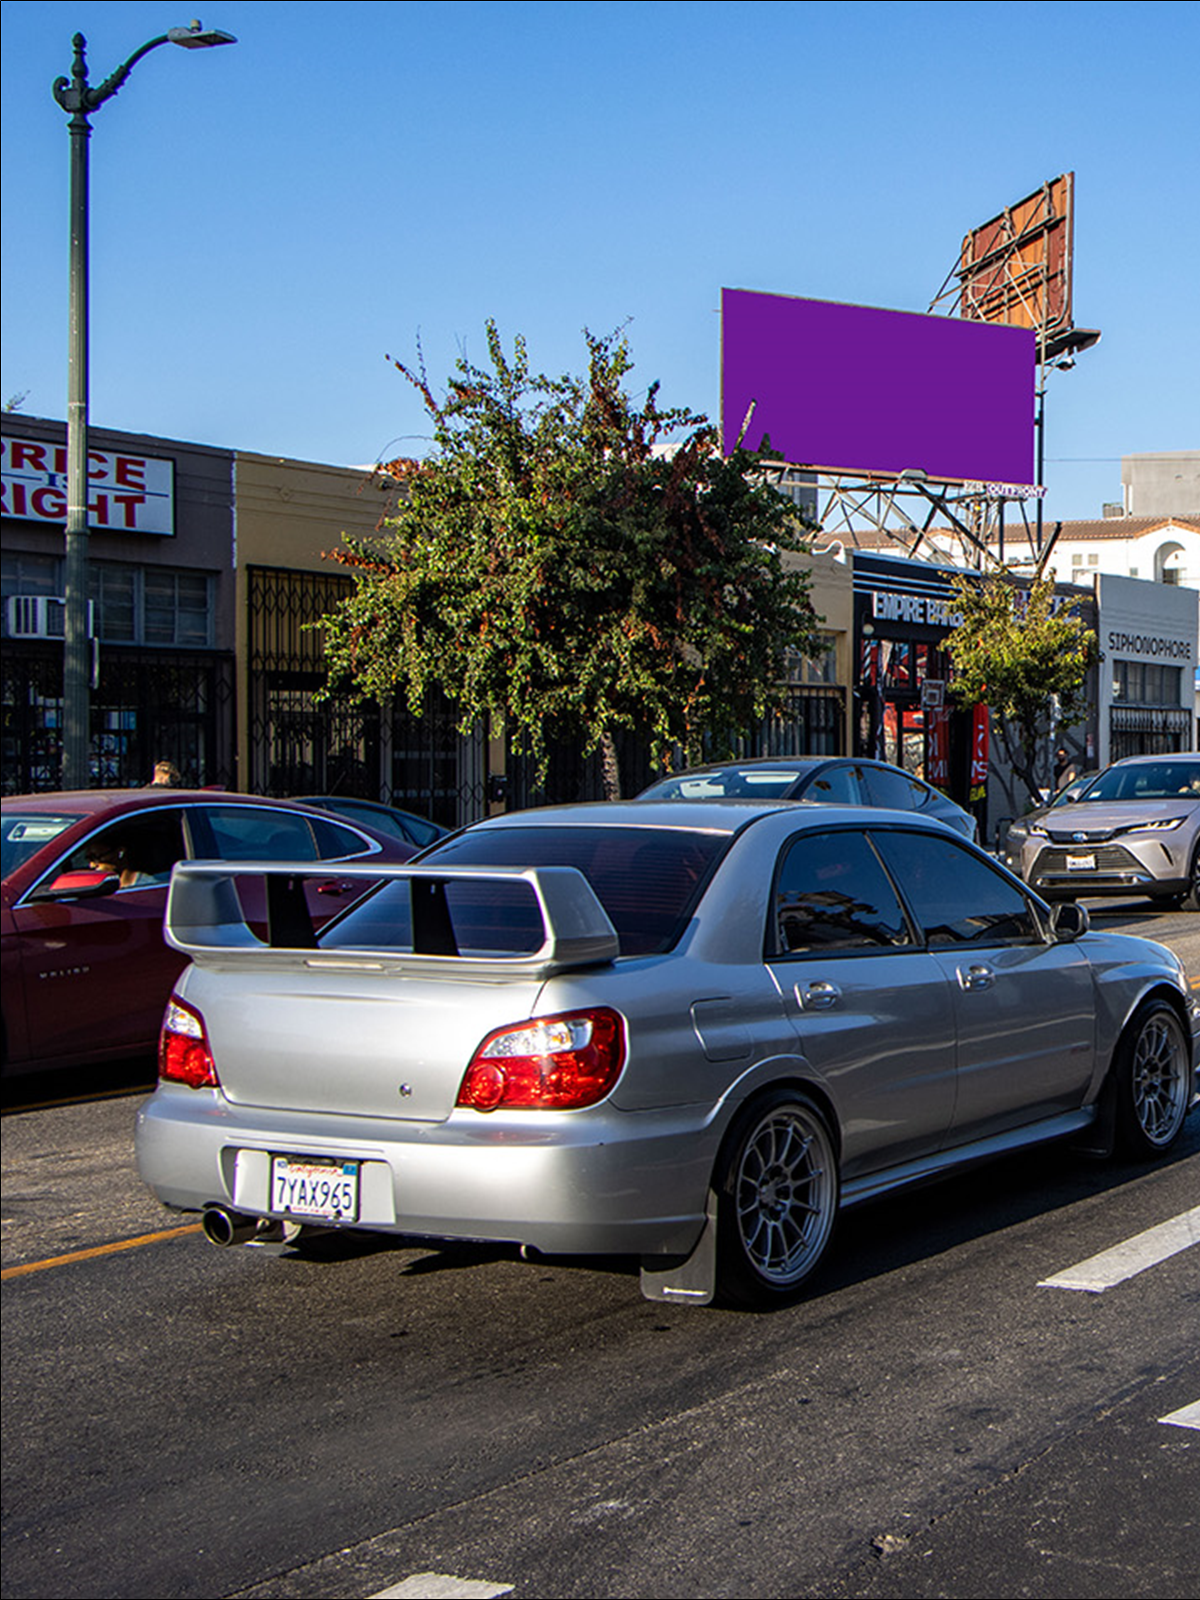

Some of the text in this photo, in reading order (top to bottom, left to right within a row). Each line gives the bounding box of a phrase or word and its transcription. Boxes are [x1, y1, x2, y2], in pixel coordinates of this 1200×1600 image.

[1, 441, 146, 491] RICE
[1, 482, 146, 528] IGHT
[873, 591, 925, 624] EMPIRE
[1108, 632, 1191, 660] SIPHONOPHORE
[40, 966, 90, 978] MALIBU
[277, 1176, 353, 1210] 7YAX965
